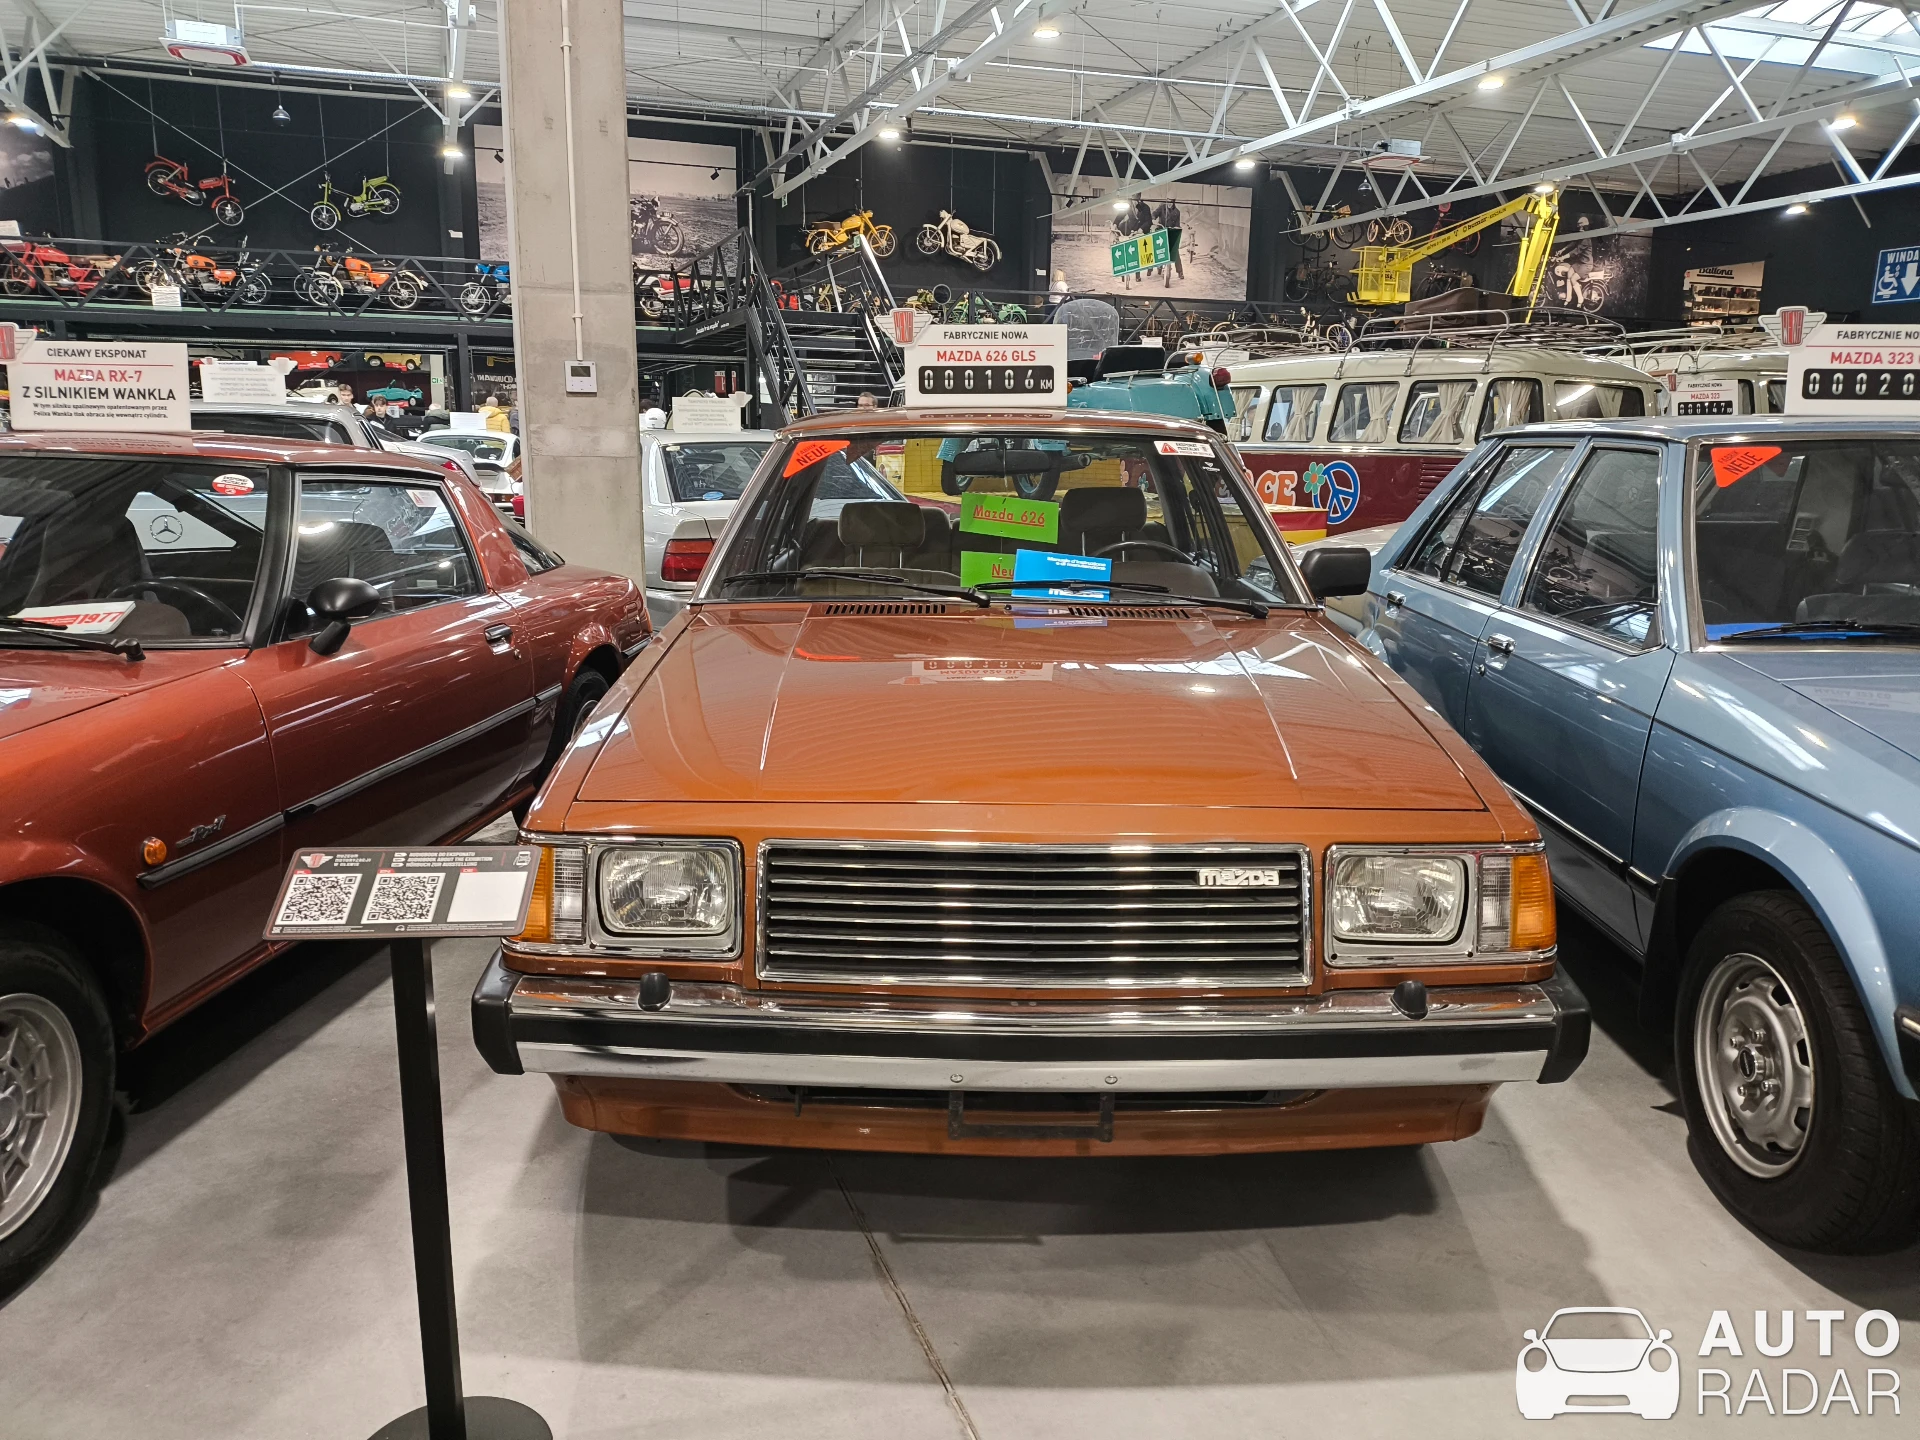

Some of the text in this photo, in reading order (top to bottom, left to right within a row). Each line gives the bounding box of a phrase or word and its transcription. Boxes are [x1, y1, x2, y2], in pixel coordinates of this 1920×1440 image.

[1888, 250, 1919, 264] WINDA
[944, 331, 1028, 340] FABRYCZNIE NOWA
[1837, 331, 1902, 340] FABRYCZNIE
[47, 349, 146, 358] CIEKAWY EKSPONAT
[936, 350, 1036, 362] MAZDA 626 GLS
[1830, 352, 1914, 364] MAZDA 323
[54, 369, 142, 382] MAZDA RX-7
[924, 369, 1053, 390] 000106 KM
[22, 386, 176, 400] Z SILNIKIEM WANKLA
[796, 444, 831, 466] NEUE
[1723, 452, 1763, 475] NEUE
[973, 505, 1045, 525] Mazda 626
[76, 612, 125, 624] 1977
